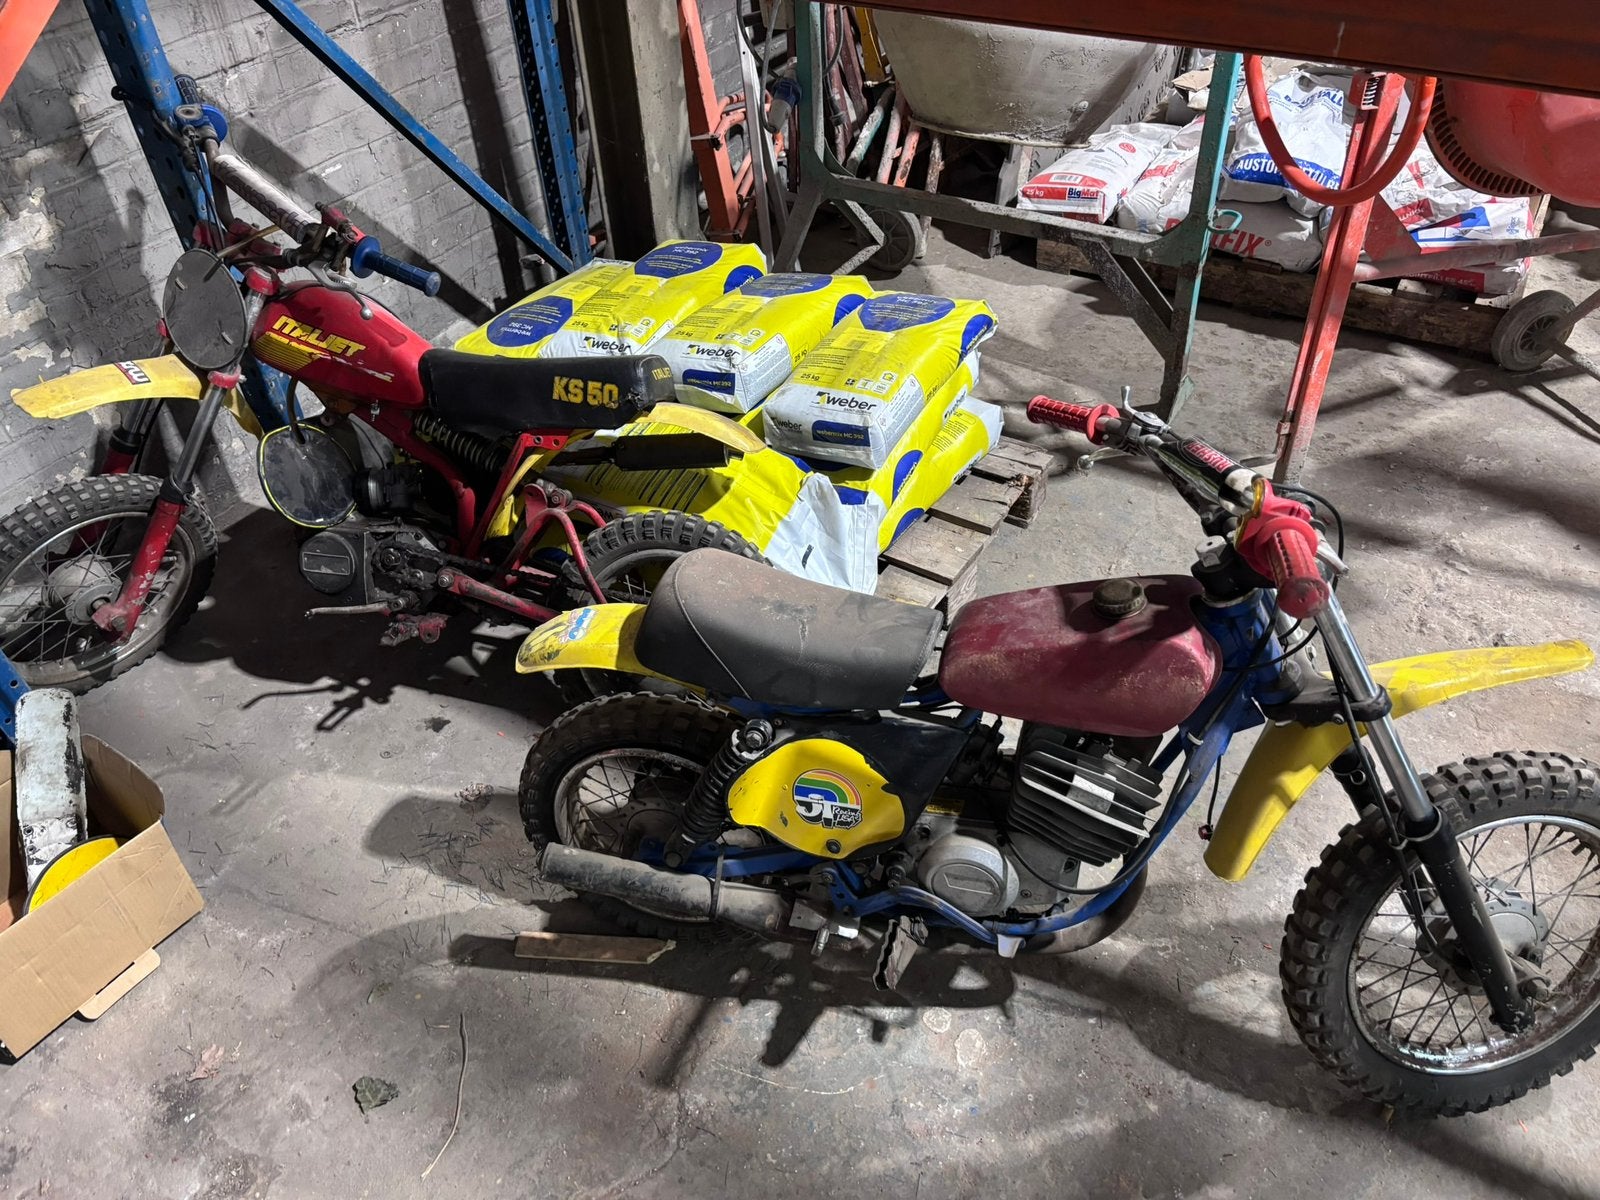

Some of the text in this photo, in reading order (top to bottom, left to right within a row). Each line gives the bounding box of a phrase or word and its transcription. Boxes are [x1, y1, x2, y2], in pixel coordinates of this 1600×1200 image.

[1068, 186, 1100, 199] BigMat
[272, 315, 366, 357] ITALJET
[591, 339, 631, 353] weber
[695, 345, 741, 357] weber
[553, 376, 619, 409] KS 50
[826, 393, 877, 411] weber
[777, 419, 802, 431] weber
